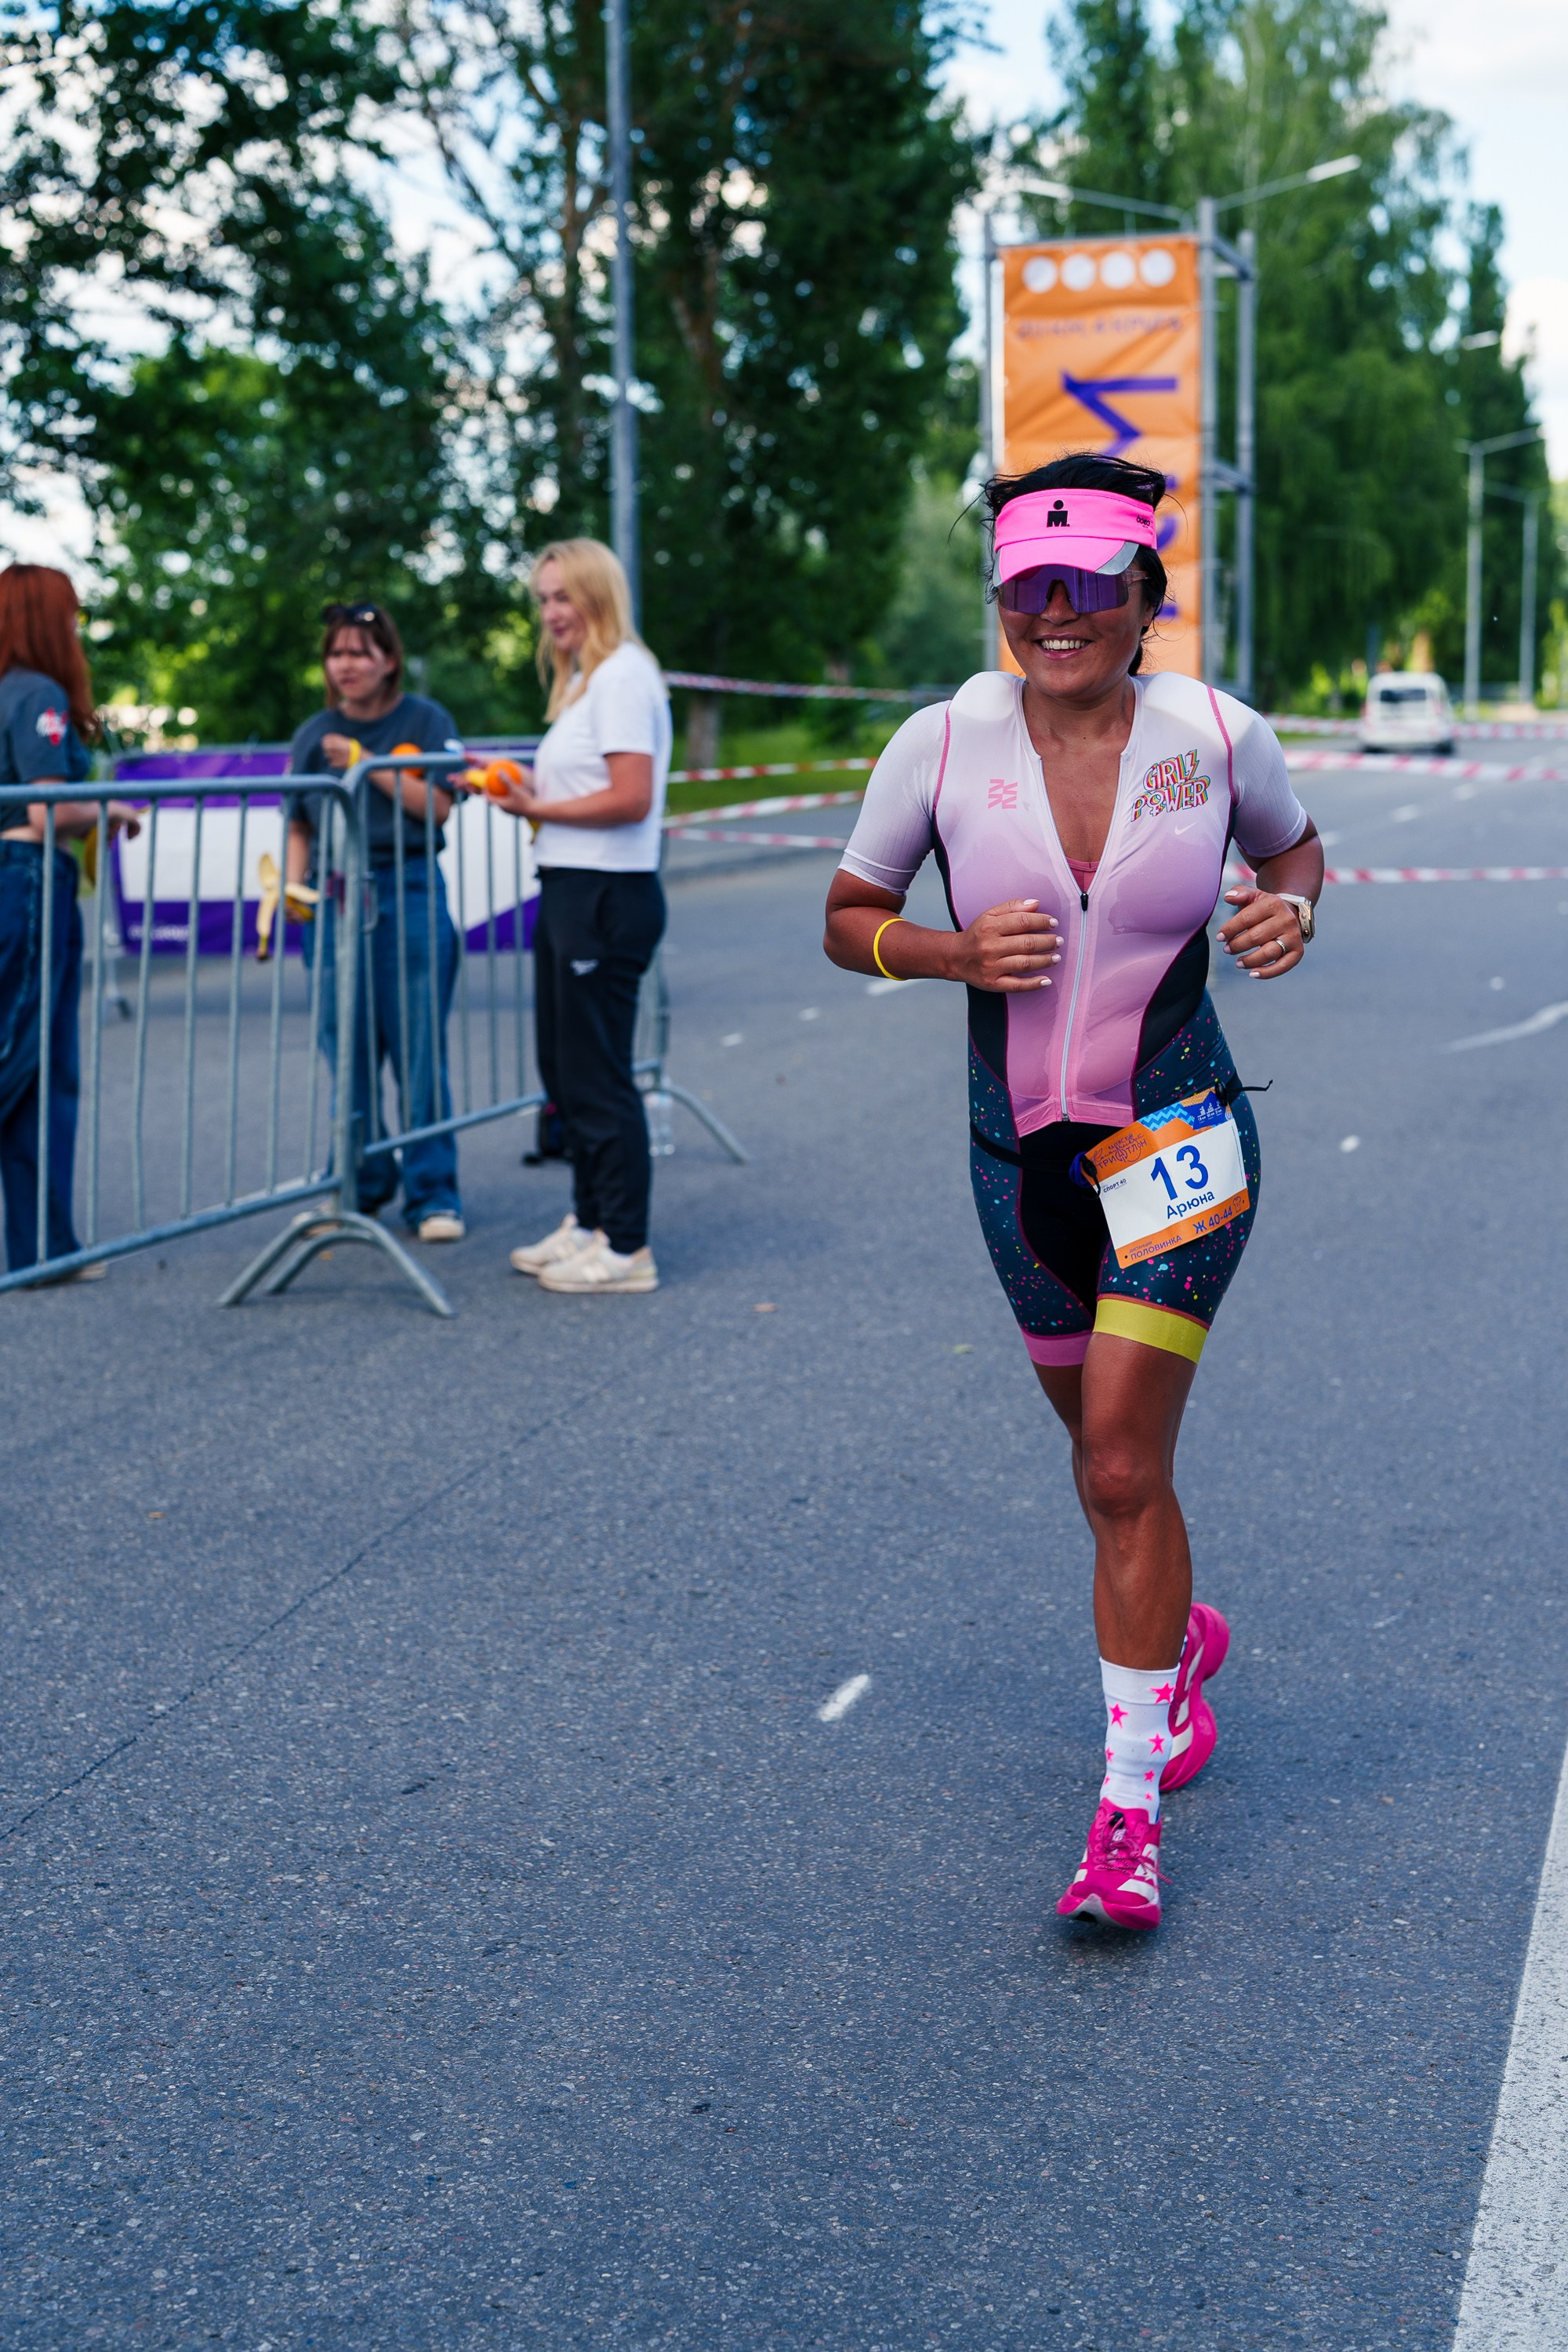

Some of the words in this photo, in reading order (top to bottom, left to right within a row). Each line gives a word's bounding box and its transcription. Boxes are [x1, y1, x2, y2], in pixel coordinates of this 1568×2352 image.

[1131, 775, 1210, 822] POWER
[1151, 1145, 1208, 1200] 13
[1103, 1182, 1120, 1192] СПОРТ
[1167, 1191, 1215, 1219] Арюна
[1192, 1220, 1207, 1234] Ж
[1208, 1206, 1232, 1227] 40-44
[1131, 1235, 1182, 1261] ПОЛОВИНКА
